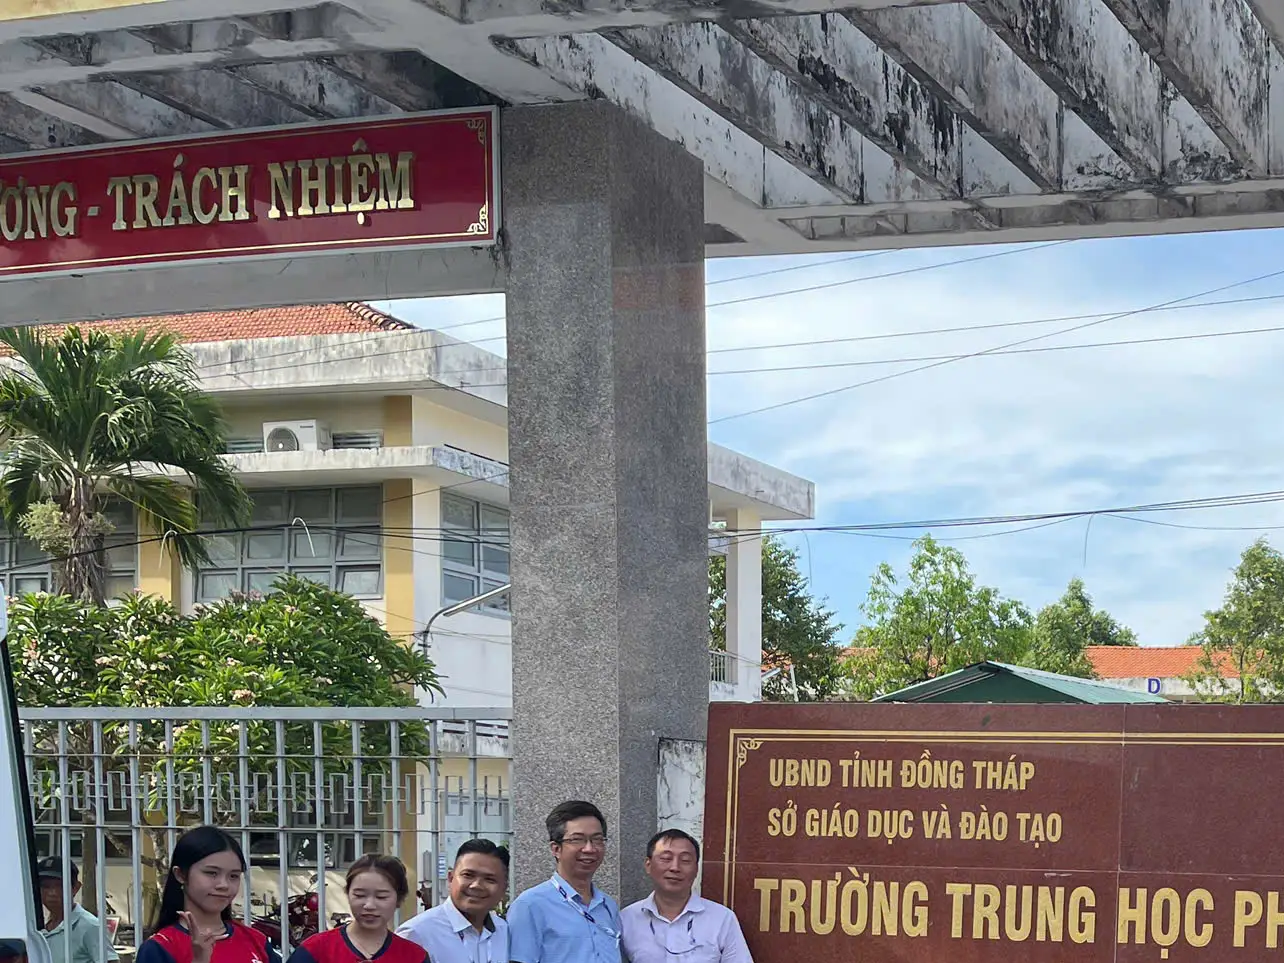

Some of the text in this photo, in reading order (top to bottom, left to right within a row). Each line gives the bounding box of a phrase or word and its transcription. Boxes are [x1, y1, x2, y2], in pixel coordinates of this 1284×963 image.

[0, 176, 77, 241] ƠNG
[106, 153, 249, 230] TRÁCH
[268, 138, 414, 225] NHIỆM
[1147, 678, 1161, 694] D
[769, 749, 1035, 790] UBND TỈNH ĐỒNG THÁP
[767, 800, 1063, 848] SỞ GIÁO DỤC VÀ ĐÀO TẠO
[753, 866, 929, 937] TRƯỜNG
[945, 883, 1096, 944] TRUNG
[1117, 887, 1215, 960] HỌC
